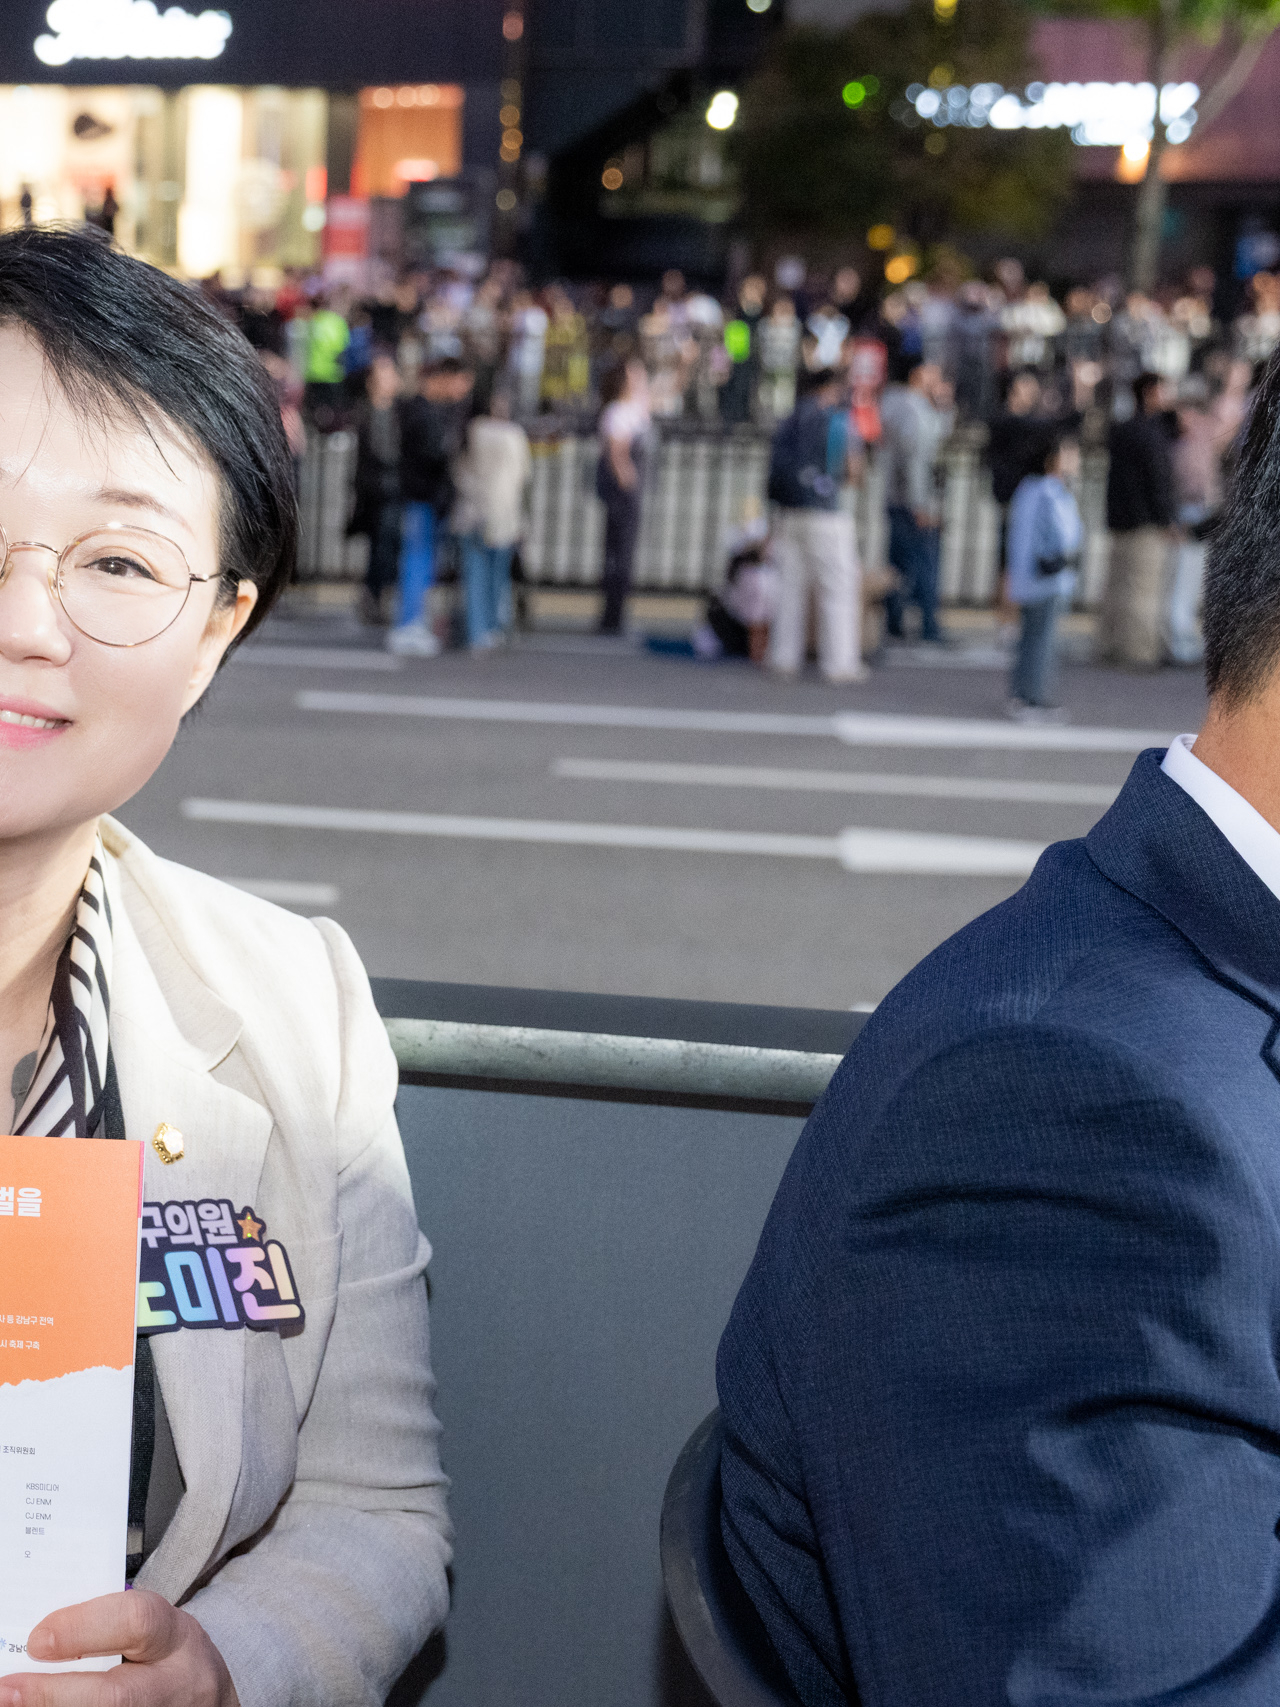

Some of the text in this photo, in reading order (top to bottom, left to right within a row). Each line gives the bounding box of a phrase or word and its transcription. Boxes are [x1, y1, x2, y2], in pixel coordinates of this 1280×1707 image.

[6, 1314, 15, 1325] 등
[15, 1314, 38, 1326] 강남구
[39, 1316, 55, 1327] 전역
[9, 1339, 24, 1350] 축제
[25, 1340, 41, 1351] 구축
[3, 1445, 36, 1456] 조직위원회
[25, 1482, 60, 1492] KBS미디어
[25, 1497, 52, 1506] CJ ENM
[25, 1512, 52, 1521] CJ ENM
